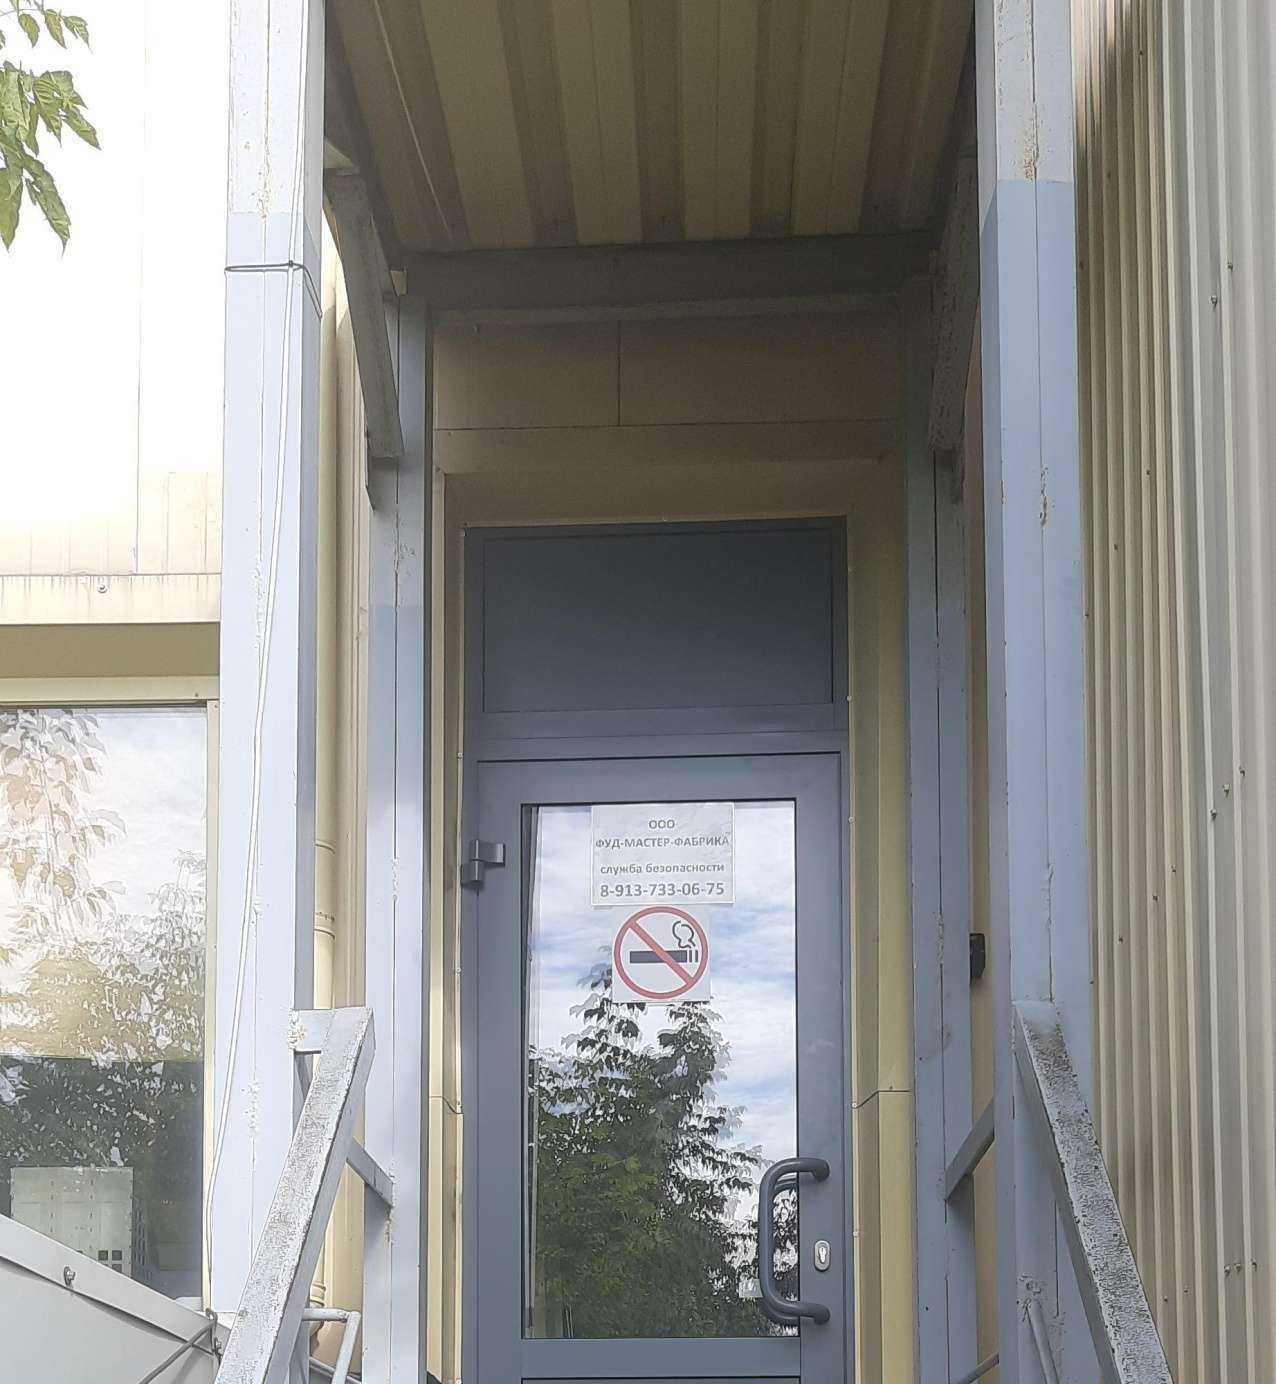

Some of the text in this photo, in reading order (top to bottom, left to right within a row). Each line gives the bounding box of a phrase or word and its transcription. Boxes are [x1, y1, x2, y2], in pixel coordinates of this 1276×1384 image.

[649, 819, 675, 829] ООО
[595, 836, 730, 850] ФУД-МАСТЕР-ФАБРИКА
[600, 863, 724, 875] служба безопасности
[600, 882, 725, 897] 8-913-733-06-75
